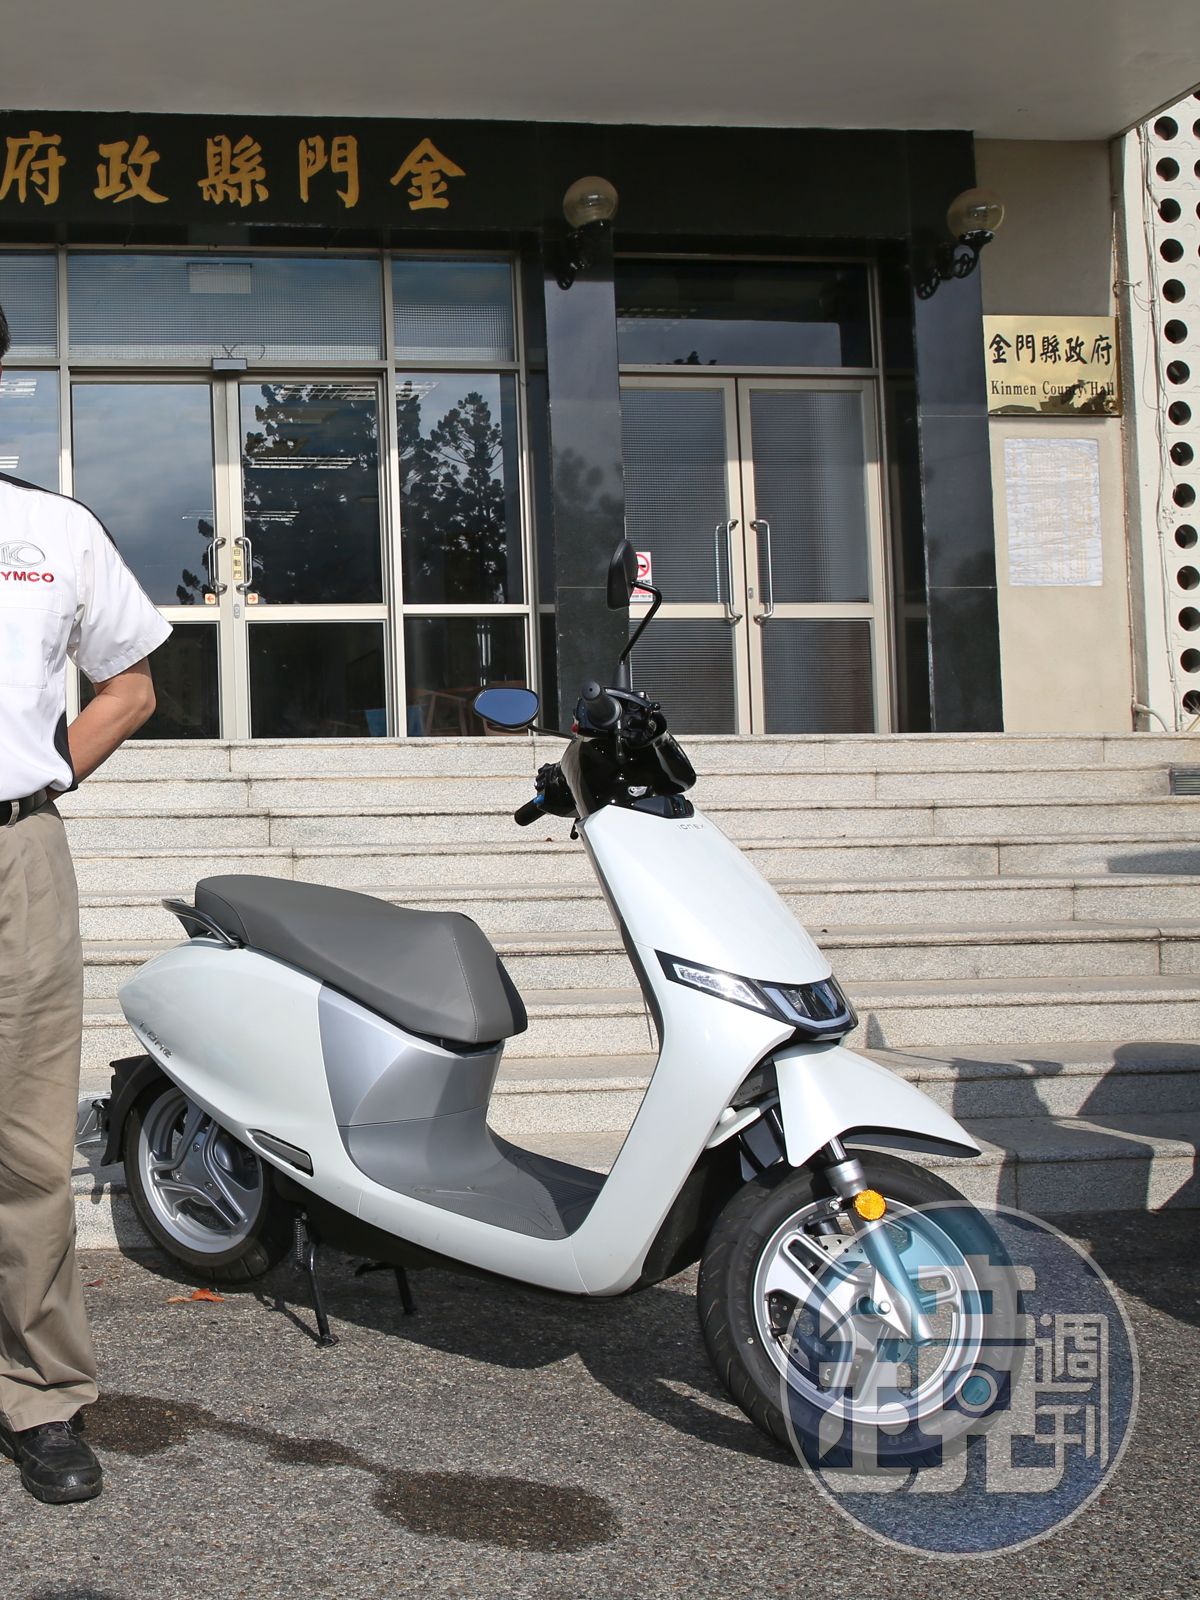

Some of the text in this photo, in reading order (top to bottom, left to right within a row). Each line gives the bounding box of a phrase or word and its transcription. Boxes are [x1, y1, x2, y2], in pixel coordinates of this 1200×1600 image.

[988, 333, 1113, 366] 金門縣政府
[991, 380, 1115, 399] Kinmen Couny Hall
